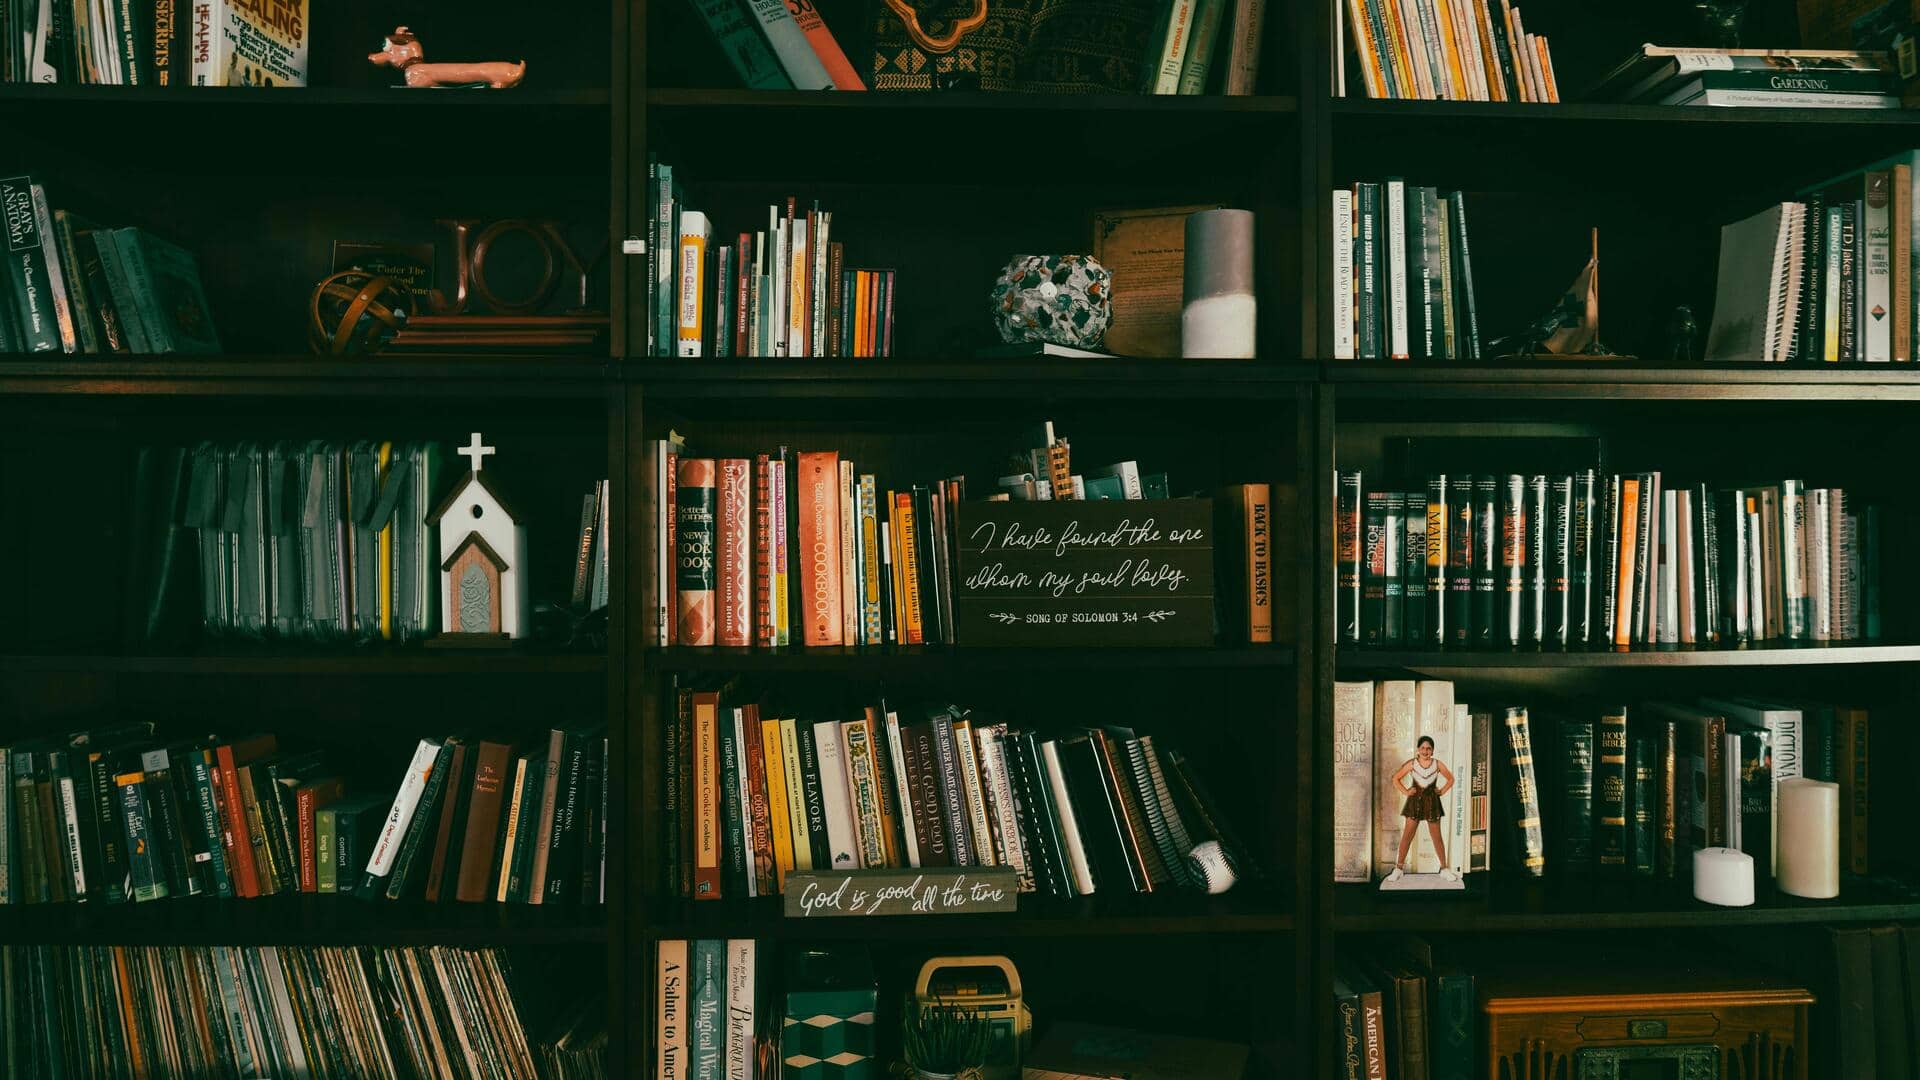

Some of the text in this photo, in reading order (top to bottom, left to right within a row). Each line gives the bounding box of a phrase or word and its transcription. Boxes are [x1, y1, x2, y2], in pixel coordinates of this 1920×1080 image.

[156, 1, 169, 66] SECRETS
[200, 4, 210, 63] HEALING
[224, 27, 239, 43] THE
[231, 14, 296, 58] 1,739 REMARKABLE
[796, 12, 820, 25] HOURS
[269, 45, 288, 62] FROM
[1171, 28, 1185, 58] WORLD
[262, 60, 290, 81] EXPERTS
[1770, 75, 1829, 91] GARDENING
[3, 184, 24, 245] ANATOMY
[16, 192, 33, 234] GRAY'S
[1339, 196, 1351, 212] THE
[1339, 213, 1352, 233] END
[1364, 214, 1373, 240] UNITED
[1831, 215, 1840, 250] DARING
[1843, 224, 1854, 248] T.D.
[432, 221, 609, 314] JOY
[1340, 248, 1351, 265] THE
[1364, 241, 1373, 264] STATES
[1809, 207, 1821, 330] COMPANION BOOK OF ENOCH
[1842, 249, 1854, 276] Jakes
[1340, 266, 1352, 290] ROAD
[1364, 265, 1374, 293] HISTORY
[740, 312, 748, 333] PRAYER
[1845, 302, 1855, 329] Leading
[1844, 332, 1854, 348] Lady
[971, 519, 1204, 557] I have found the one
[1366, 525, 1382, 569] FORCE
[1428, 511, 1442, 559] MARK
[1557, 502, 1567, 565] ARMAGEDDON
[1254, 503, 1268, 606] BACK TO BASICS
[726, 532, 734, 632] PICTURE COOK BOOK
[813, 542, 830, 621] COOKBOOK
[965, 563, 1033, 590] whom
[1038, 571, 1076, 597] my
[1074, 559, 1132, 594] soul
[1025, 611, 1138, 623] SONG OF SOLOMON 3:4
[1334, 722, 1367, 744] HOLY
[1602, 731, 1625, 740] HOLY
[1602, 739, 1626, 748] BIBLE
[1775, 722, 1797, 779] DICTIONA
[484, 766, 497, 774] The
[569, 751, 583, 785] ENDLESS
[666, 724, 677, 810] simply slow cooking
[1334, 744, 1368, 764] BIBLE
[97, 763, 112, 822] RICHARD WRIGHT
[702, 720, 712, 852] The Great American Cookie Cookbook
[802, 730, 822, 832] NORDSTROM FLAVORS
[918, 735, 945, 853] GREAT GOOD FOOD
[939, 721, 968, 866] THE SILVER PALATE GOOD TIMES COOKBO
[963, 740, 984, 826] PERRICONE PROMISE
[999, 782, 1012, 809] BASICS
[196, 764, 218, 838] wild Cheryl Strayed
[724, 738, 744, 872] market vegetarian Ross Dobson
[134, 815, 144, 831] Carl
[552, 808, 565, 848] SHY DAWN
[754, 794, 767, 850] COOKY BOOK
[914, 799, 927, 844] ROSSO
[1002, 811, 1019, 855] COOKBOOK
[320, 835, 329, 850] long
[339, 837, 348, 866] comfort
[799, 874, 1006, 917] God is good all the time
[732, 966, 740, 1002] Every Mood
[739, 948, 749, 989] Music for Your
[664, 960, 681, 1080] A Salute to Amer
[694, 999, 719, 1051] Magical
[1367, 1007, 1380, 1073] AMERICAN
[699, 1052, 718, 1080] Wor
